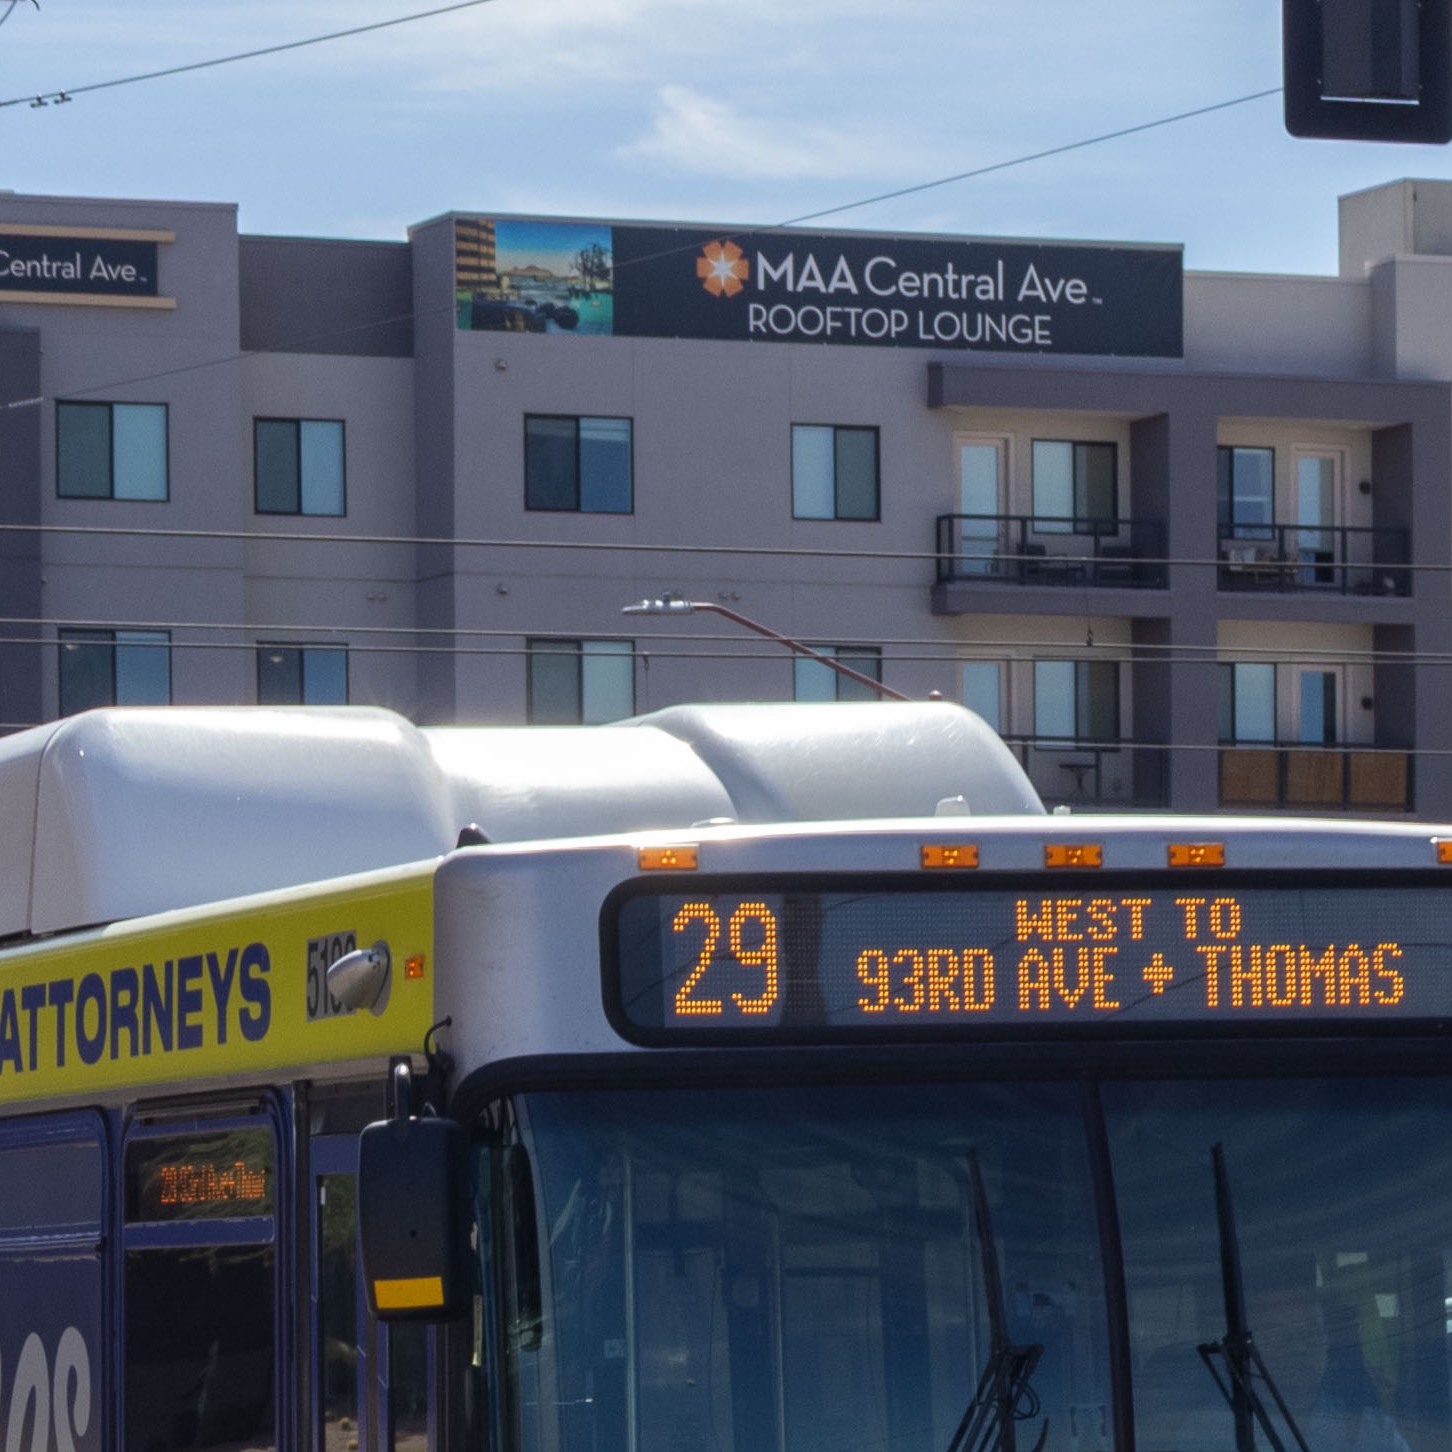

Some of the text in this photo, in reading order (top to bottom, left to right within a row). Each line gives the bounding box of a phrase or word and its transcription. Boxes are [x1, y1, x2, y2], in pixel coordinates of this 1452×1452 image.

[756, 251, 859, 296] MAA
[864, 256, 1005, 302] Central
[749, 303, 1053, 346] ROOFTOP LOUNGE
[1016, 898, 1242, 941] WEST TO
[672, 902, 779, 1016] 29
[856, 948, 995, 1013] 93RD
[1018, 947, 1120, 1011] AVE
[1197, 942, 1406, 1008] THOMAS
